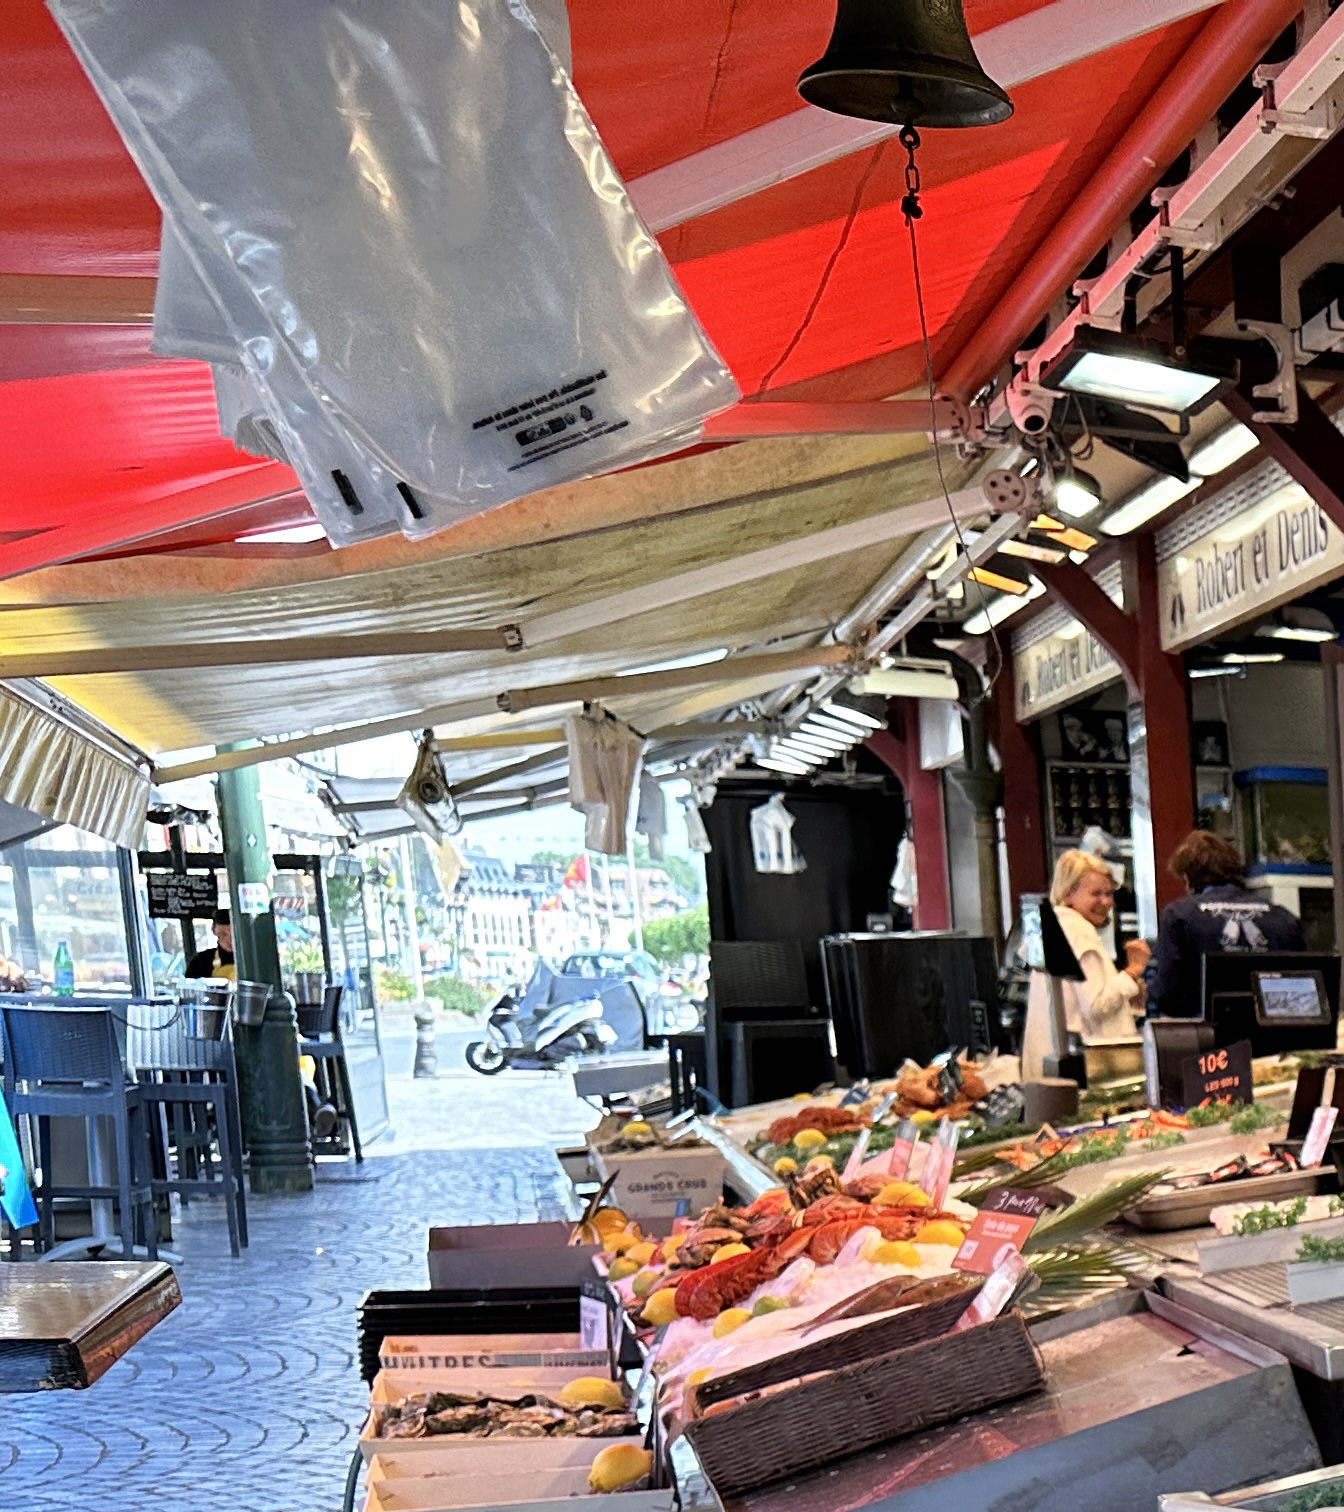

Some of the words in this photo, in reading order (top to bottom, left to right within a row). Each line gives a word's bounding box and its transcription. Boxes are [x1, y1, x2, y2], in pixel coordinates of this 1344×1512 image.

[1195, 540, 1244, 615] Robert
[1253, 537, 1271, 586] et
[1277, 500, 1329, 572] Denis
[1199, 1049, 1228, 1076] 10€
